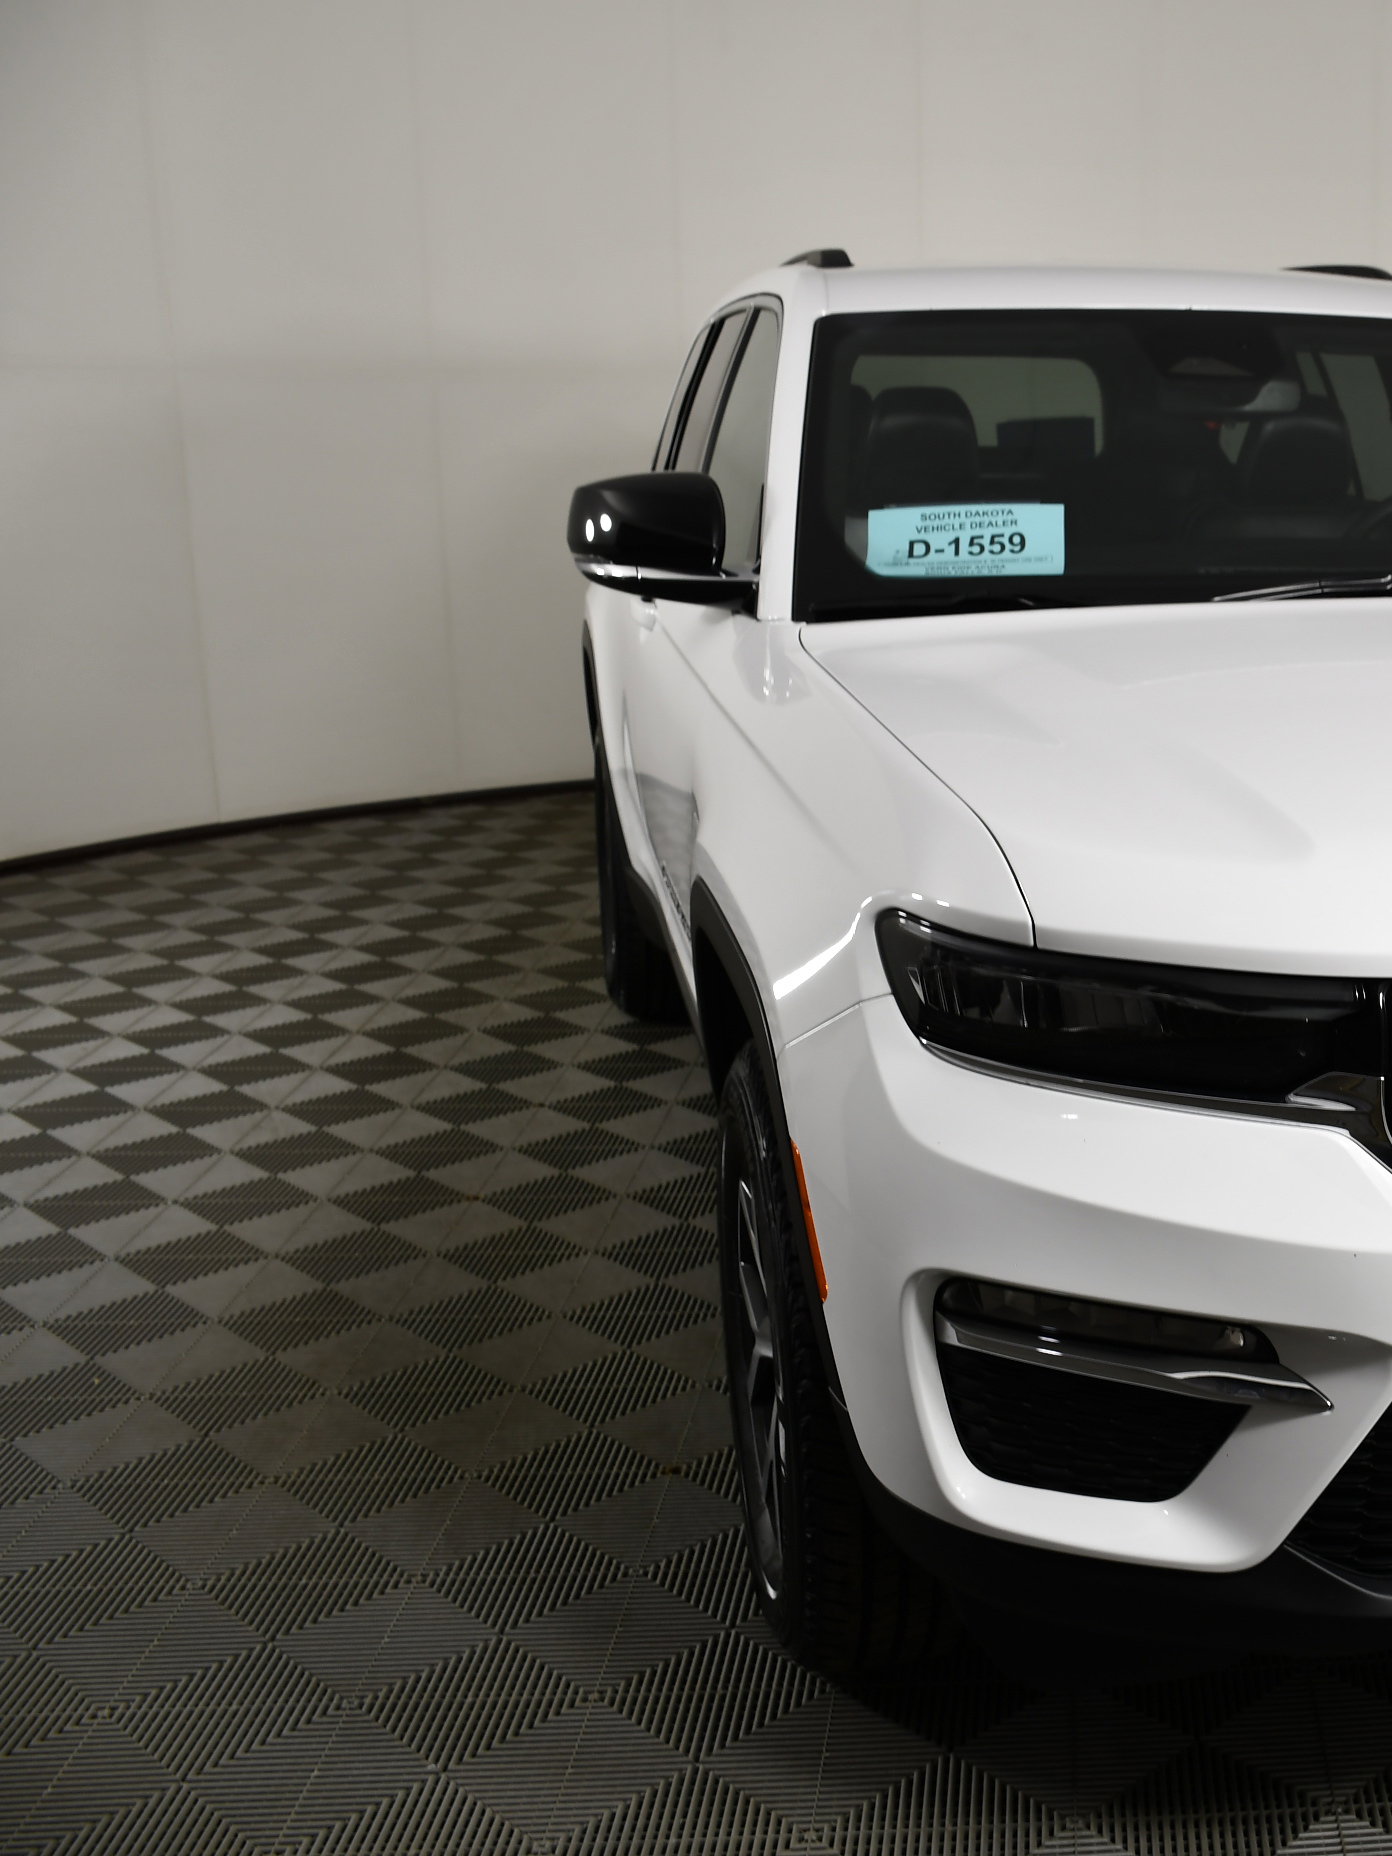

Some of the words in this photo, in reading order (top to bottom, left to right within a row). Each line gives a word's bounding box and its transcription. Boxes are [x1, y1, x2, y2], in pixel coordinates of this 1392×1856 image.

[920, 511, 962, 522] SOUTH
[964, 508, 1014, 519] DAKOTA
[915, 523, 966, 534] VEHICLE
[969, 518, 1018, 530] DEALER
[907, 532, 1027, 559] D-1559
